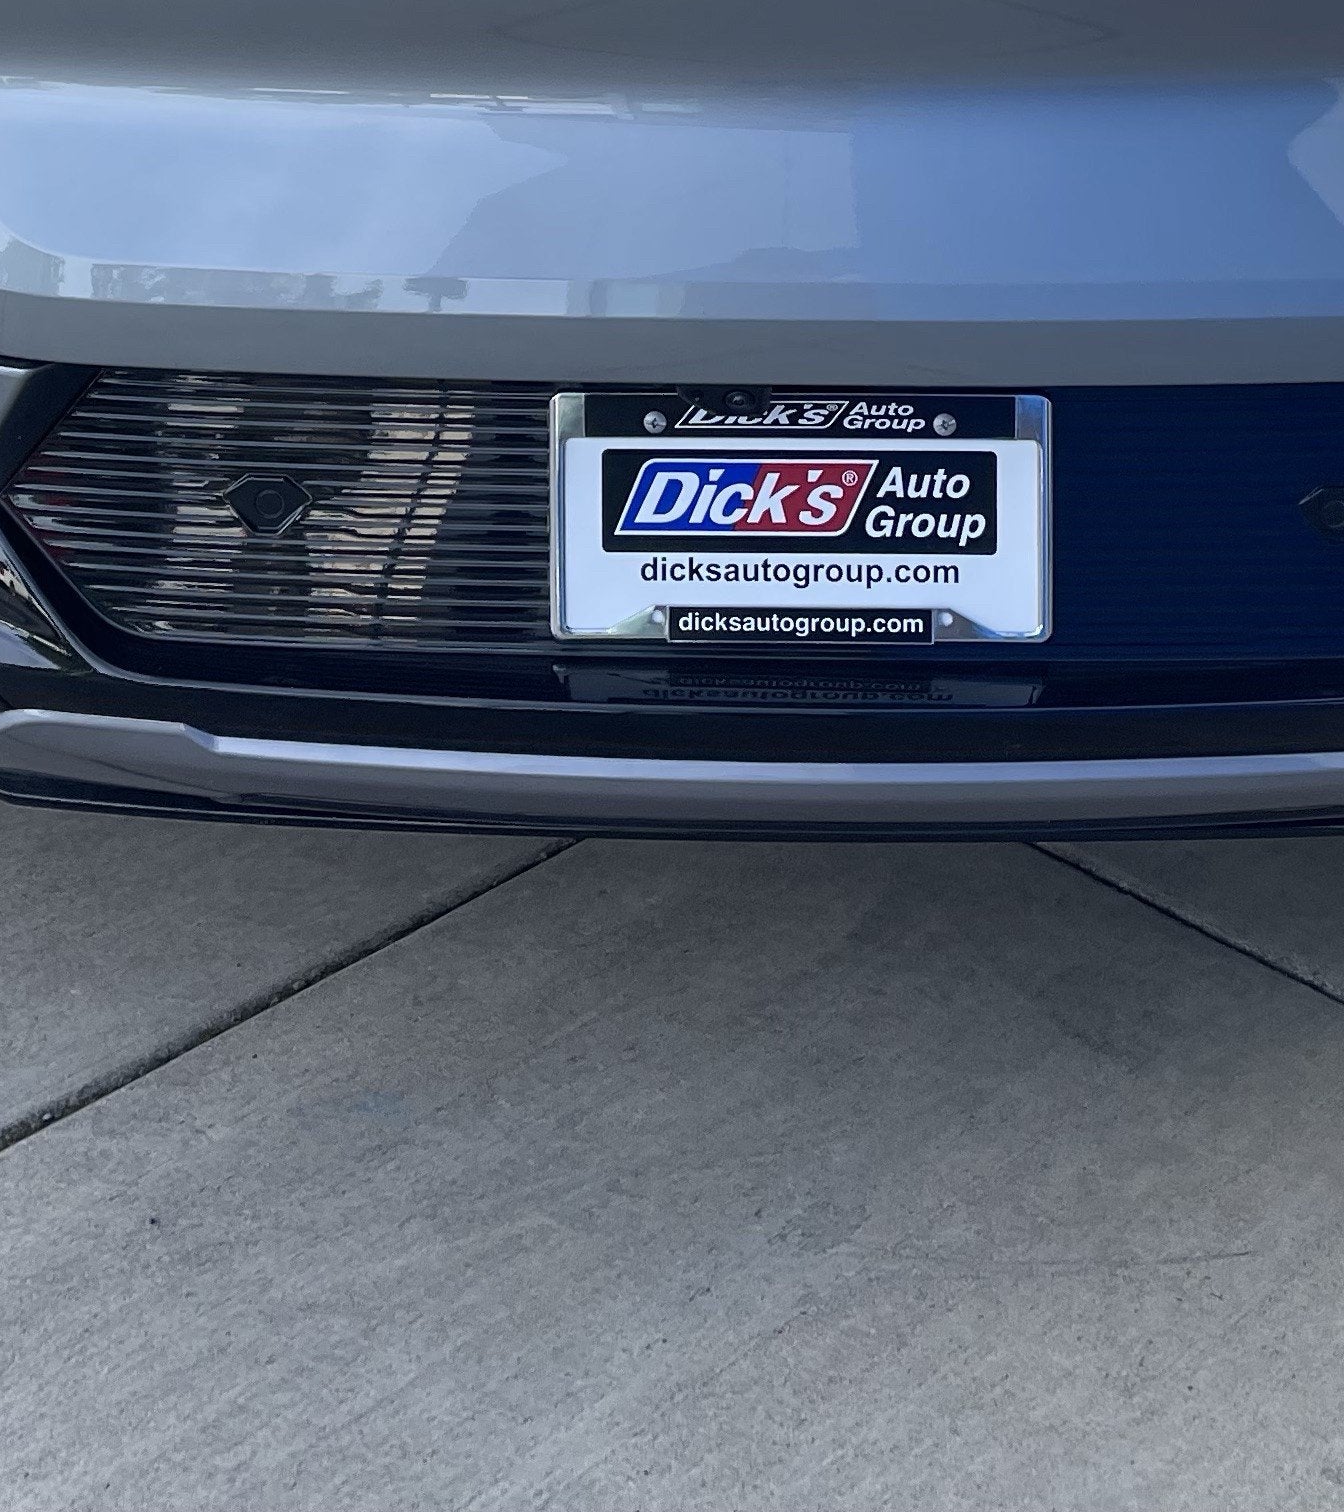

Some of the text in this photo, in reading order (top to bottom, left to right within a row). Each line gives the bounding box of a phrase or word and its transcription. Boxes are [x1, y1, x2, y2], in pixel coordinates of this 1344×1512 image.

[842, 415, 926, 432] Group
[849, 401, 914, 416] Auto
[634, 469, 844, 526] Dick's
[876, 466, 971, 499] Auto
[865, 505, 986, 547] Group
[640, 556, 960, 589] dicksautogroup.com
[678, 612, 924, 636] dicksautogroup.com
